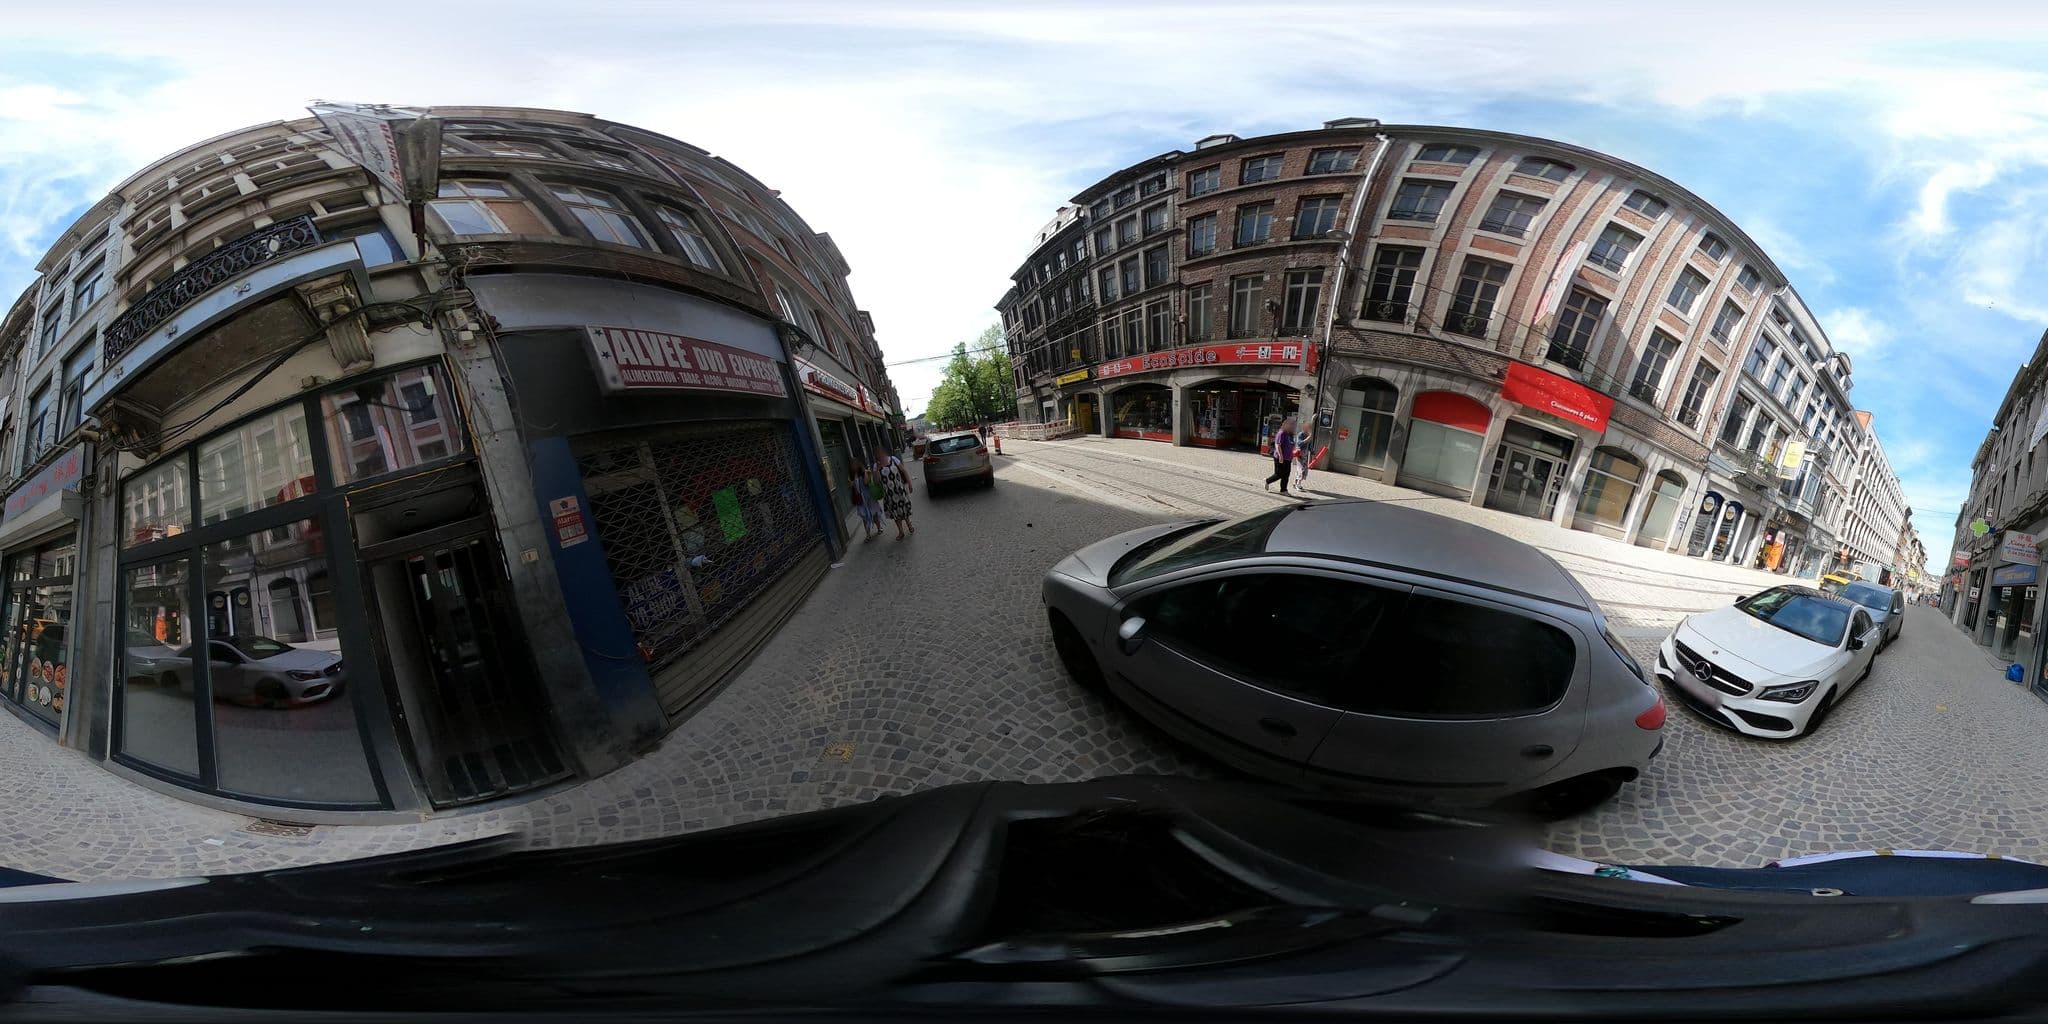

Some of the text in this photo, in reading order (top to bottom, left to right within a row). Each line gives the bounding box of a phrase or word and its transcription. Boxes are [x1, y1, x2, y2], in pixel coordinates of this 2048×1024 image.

[609, 329, 780, 383] ALVEE DVD EXPRESS
[1142, 347, 1217, 370] EcoSolde
[621, 369, 678, 384] ALIMENTATION
